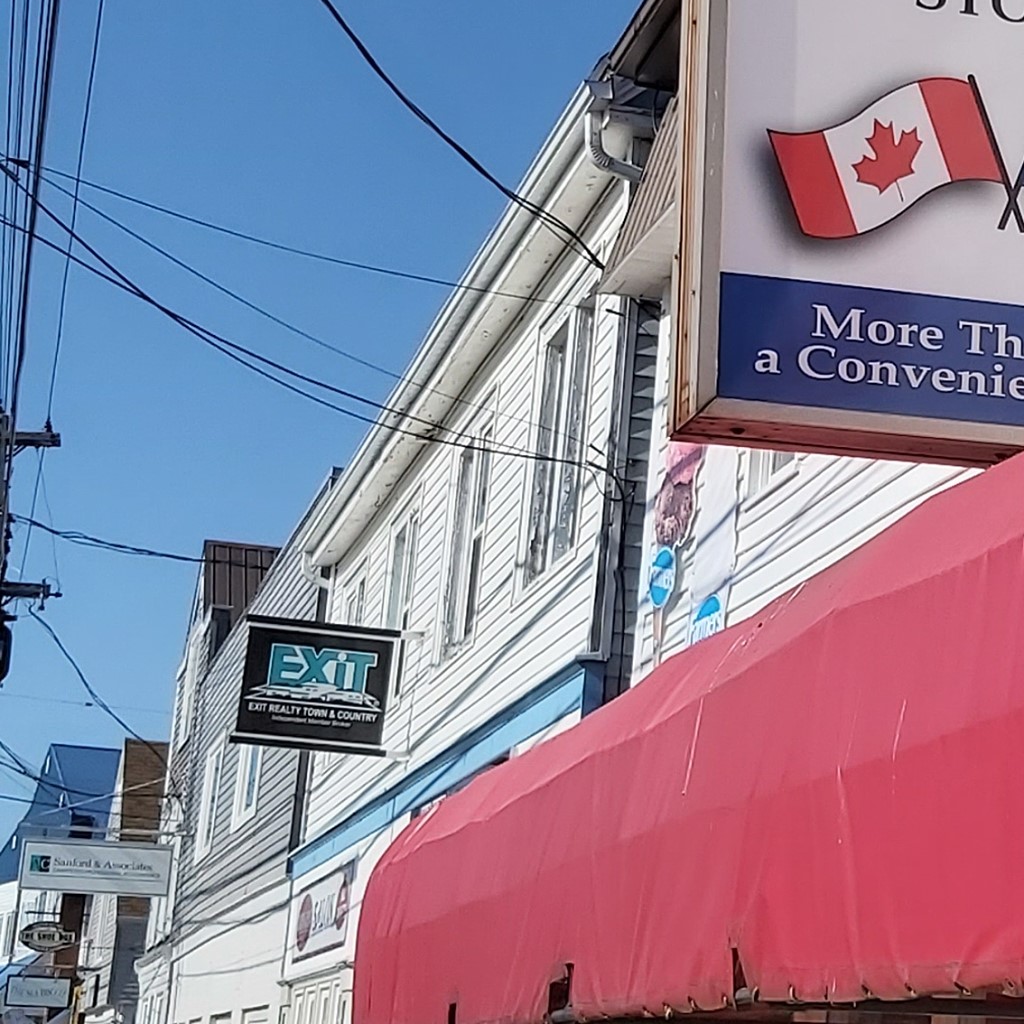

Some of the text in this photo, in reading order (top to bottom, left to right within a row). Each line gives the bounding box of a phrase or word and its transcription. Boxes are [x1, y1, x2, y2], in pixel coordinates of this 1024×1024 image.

[810, 304, 944, 351] More
[754, 348, 780, 374] a
[248, 702, 379, 724] EXIT REALTY TOWN & COUNTRY
[53, 857, 92, 868] Sanford
[104, 860, 154, 872] Associates
